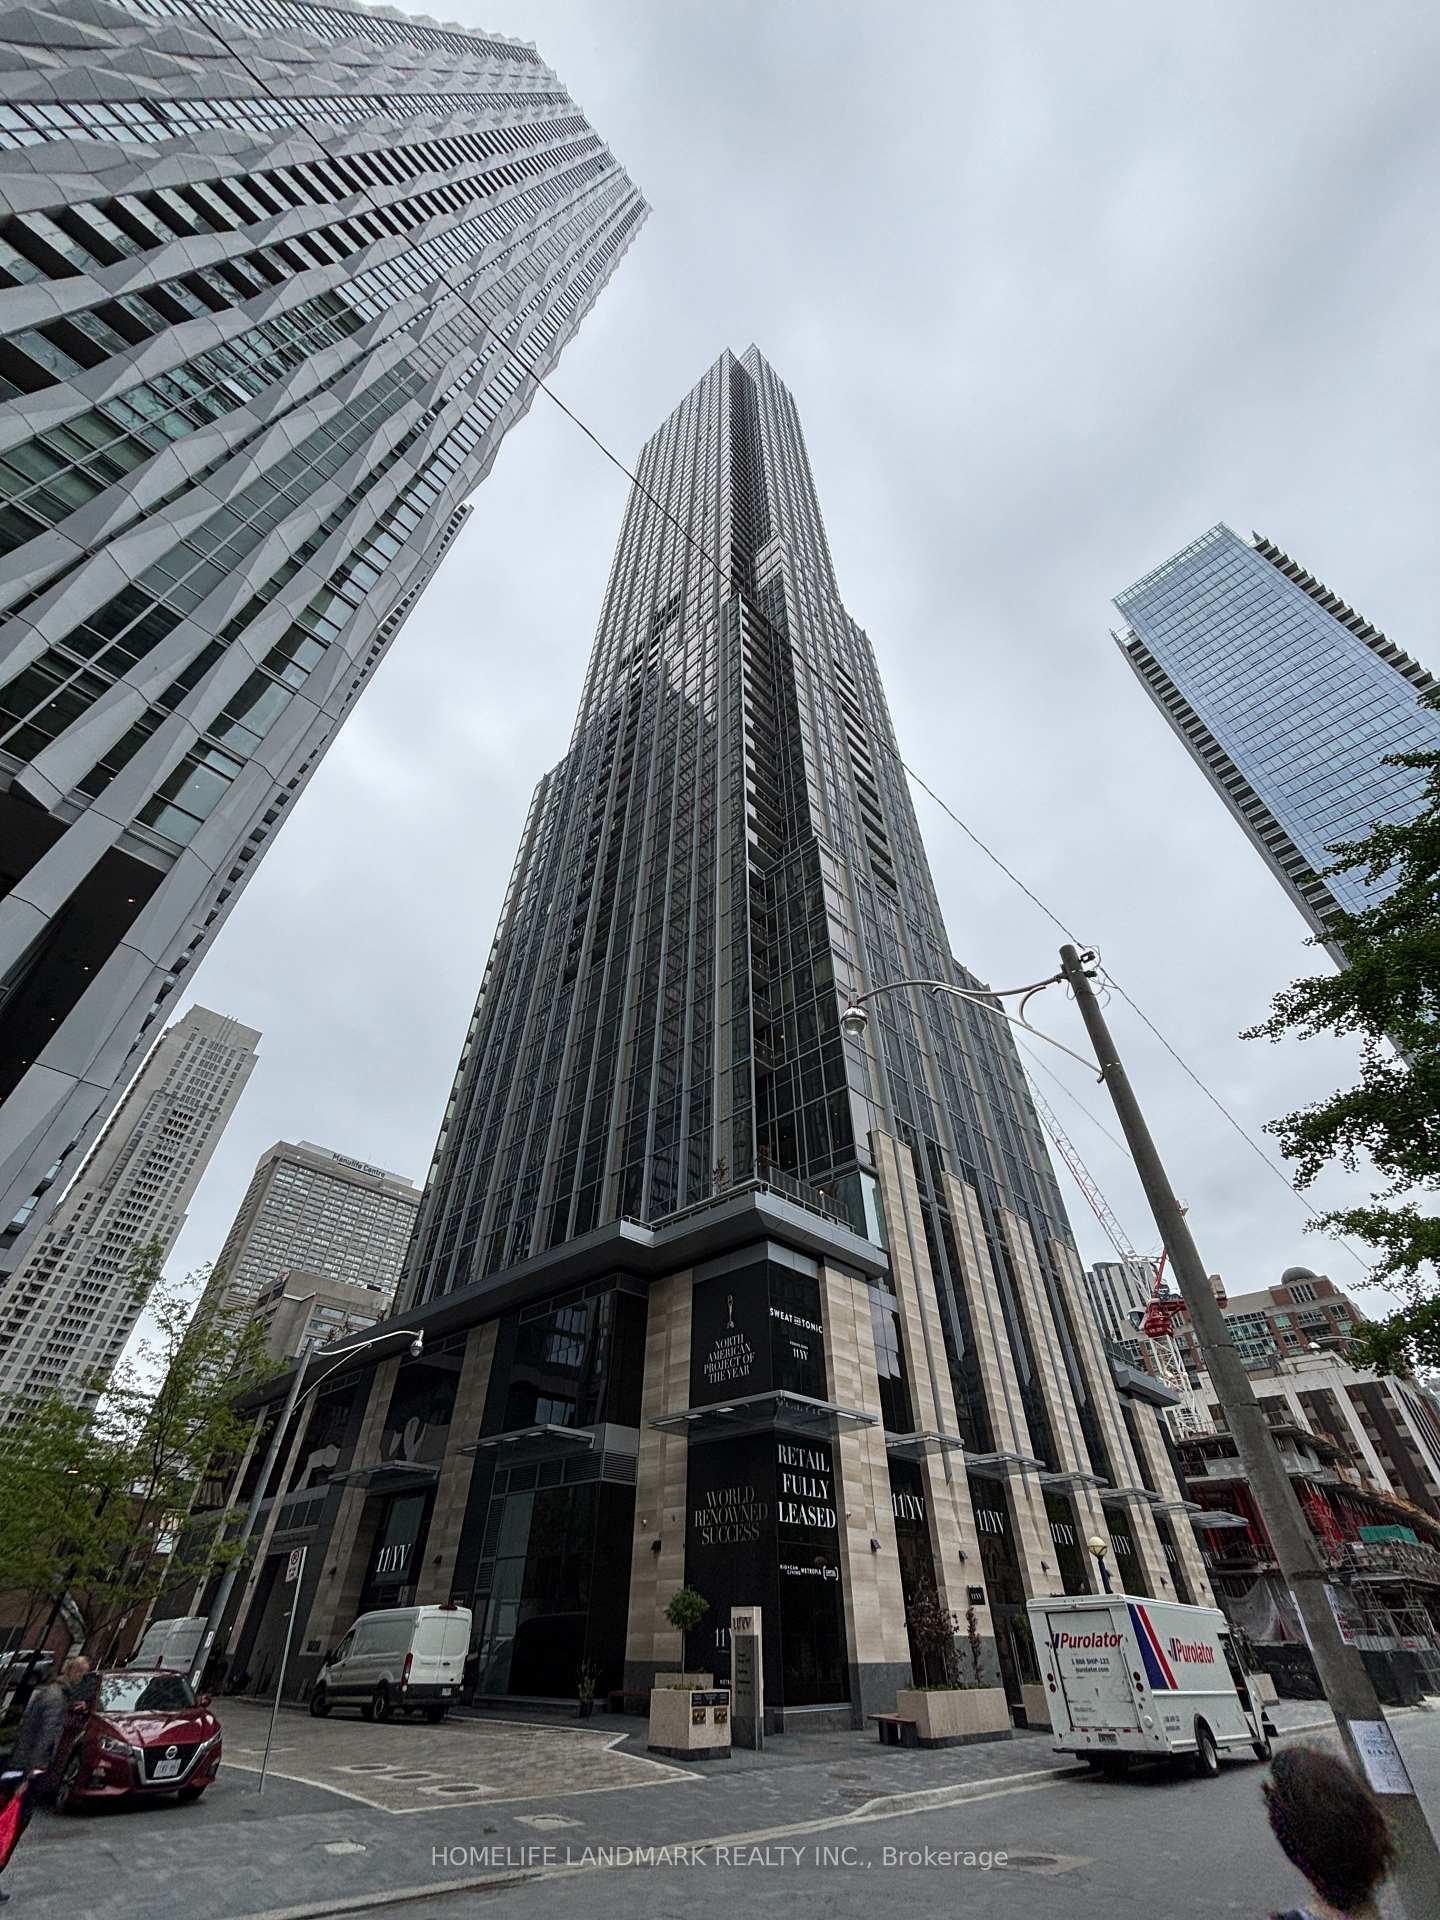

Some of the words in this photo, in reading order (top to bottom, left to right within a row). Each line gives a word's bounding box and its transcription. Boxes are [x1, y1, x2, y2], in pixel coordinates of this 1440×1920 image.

[332, 1152, 363, 1169] Manulife
[363, 1164, 386, 1178] Centre
[769, 1307, 793, 1323] SWEAT
[802, 1318, 823, 1334] TONIC
[708, 1343, 752, 1363] AMERICAN
[715, 1333, 744, 1350] NORTH
[703, 1356, 740, 1375] PROJECT
[742, 1351, 756, 1364] OF
[708, 1369, 727, 1384] THE
[726, 1364, 750, 1381] YEAR
[777, 1444, 830, 1472] RETAIL
[706, 1486, 755, 1508] WORLD
[782, 1472, 830, 1500] FULLY
[694, 1503, 769, 1528] RENOWNED
[777, 1501, 837, 1529] LEASED
[701, 1522, 760, 1545] SUCCESS
[1060, 1631, 1124, 1649] Purolator
[1176, 1638, 1215, 1665] Purolator
